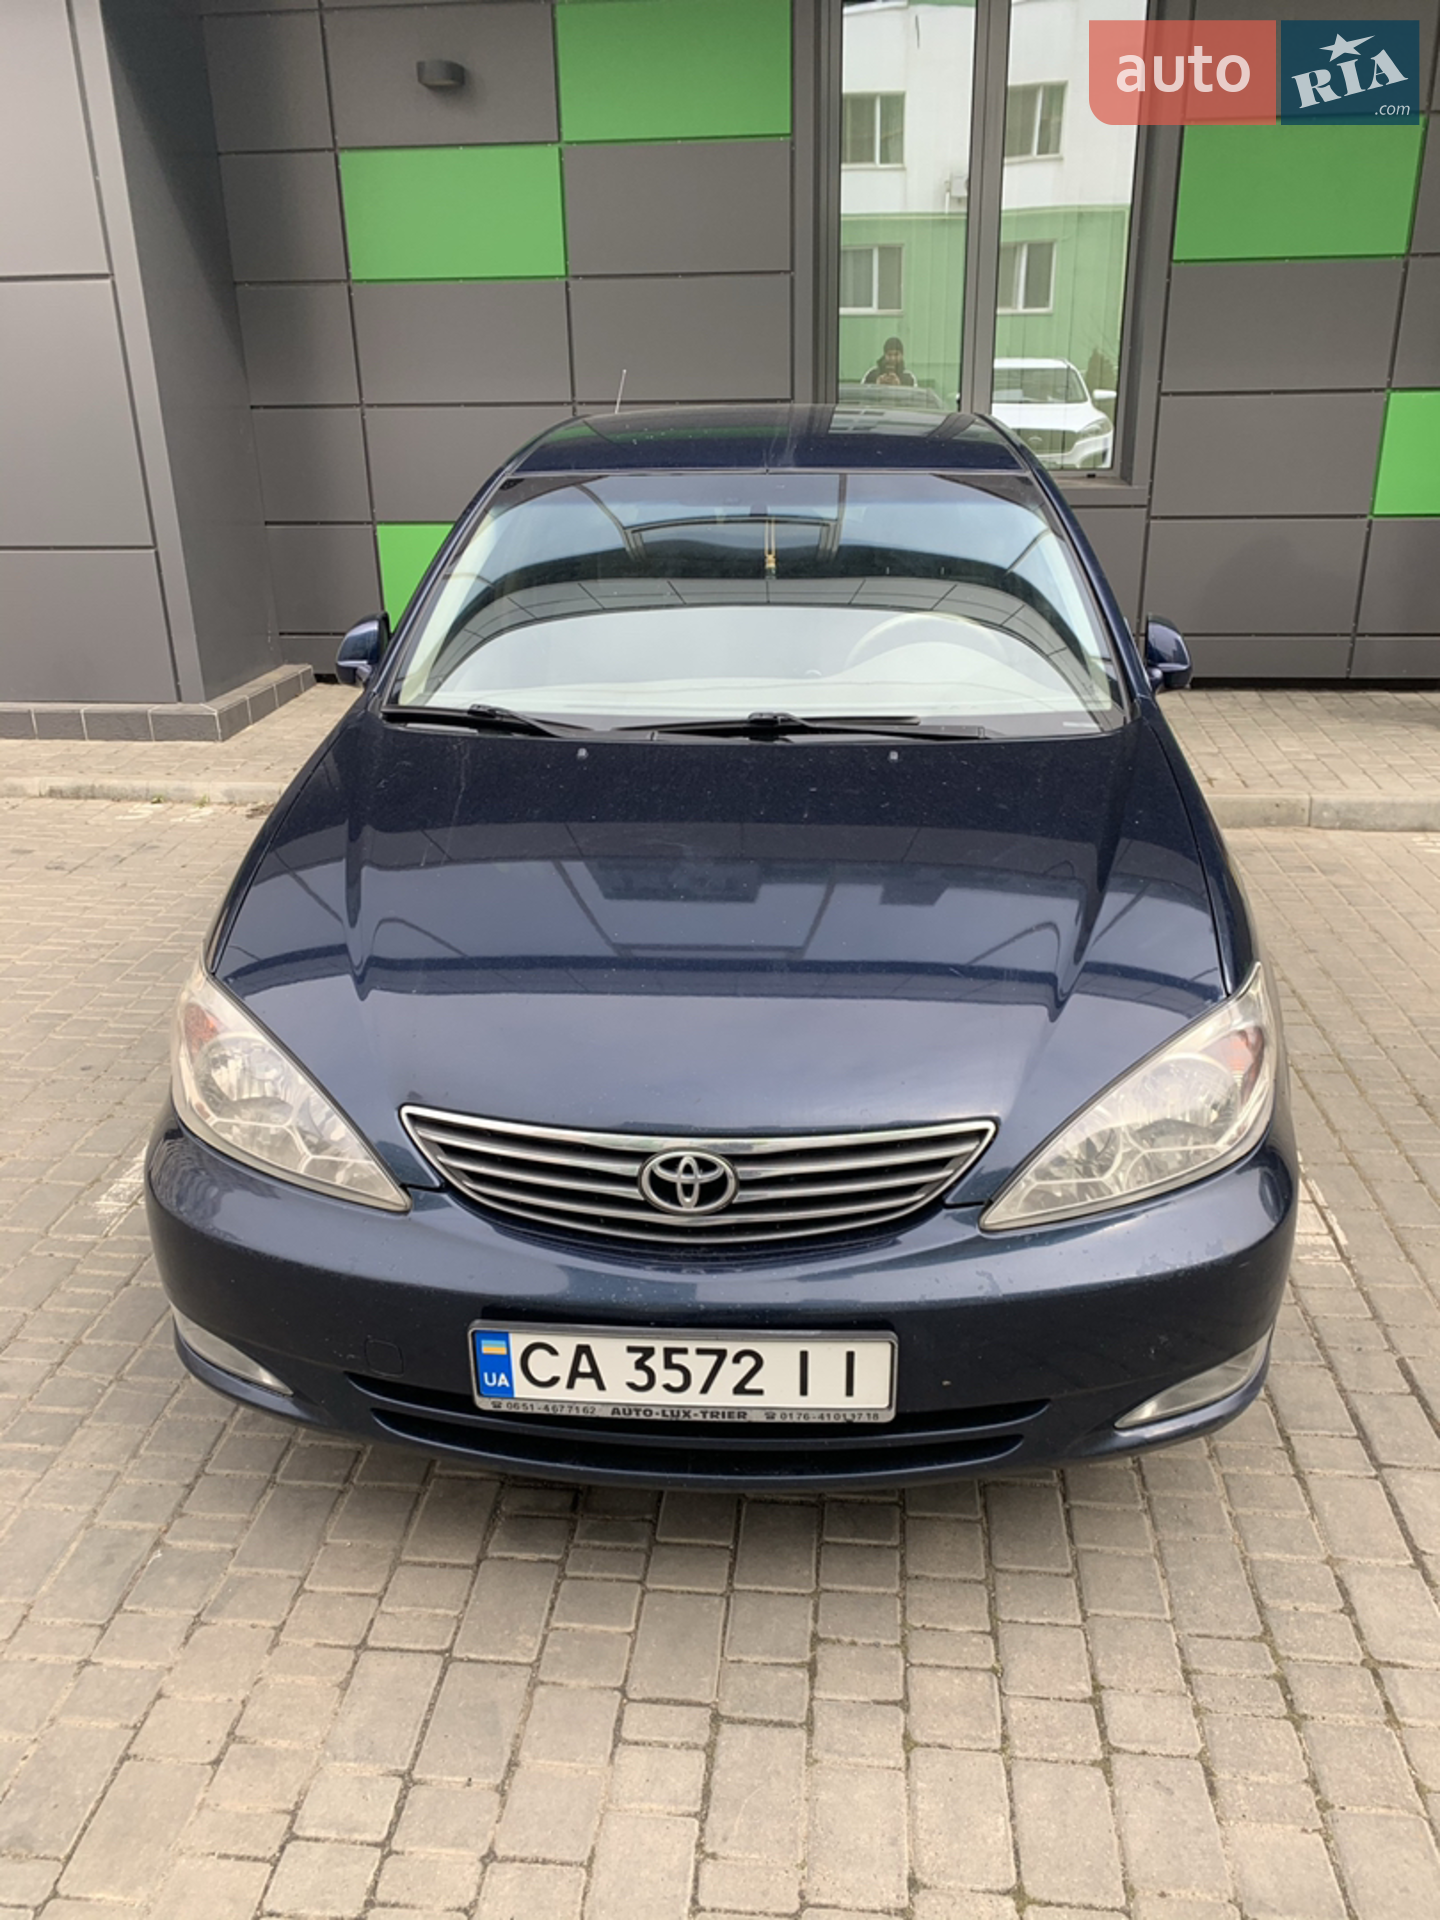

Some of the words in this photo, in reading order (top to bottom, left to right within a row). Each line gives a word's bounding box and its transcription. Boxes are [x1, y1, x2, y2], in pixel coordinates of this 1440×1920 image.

[484, 1372, 510, 1387] UA
[520, 1342, 606, 1391] CA
[625, 1346, 764, 1396] 3572
